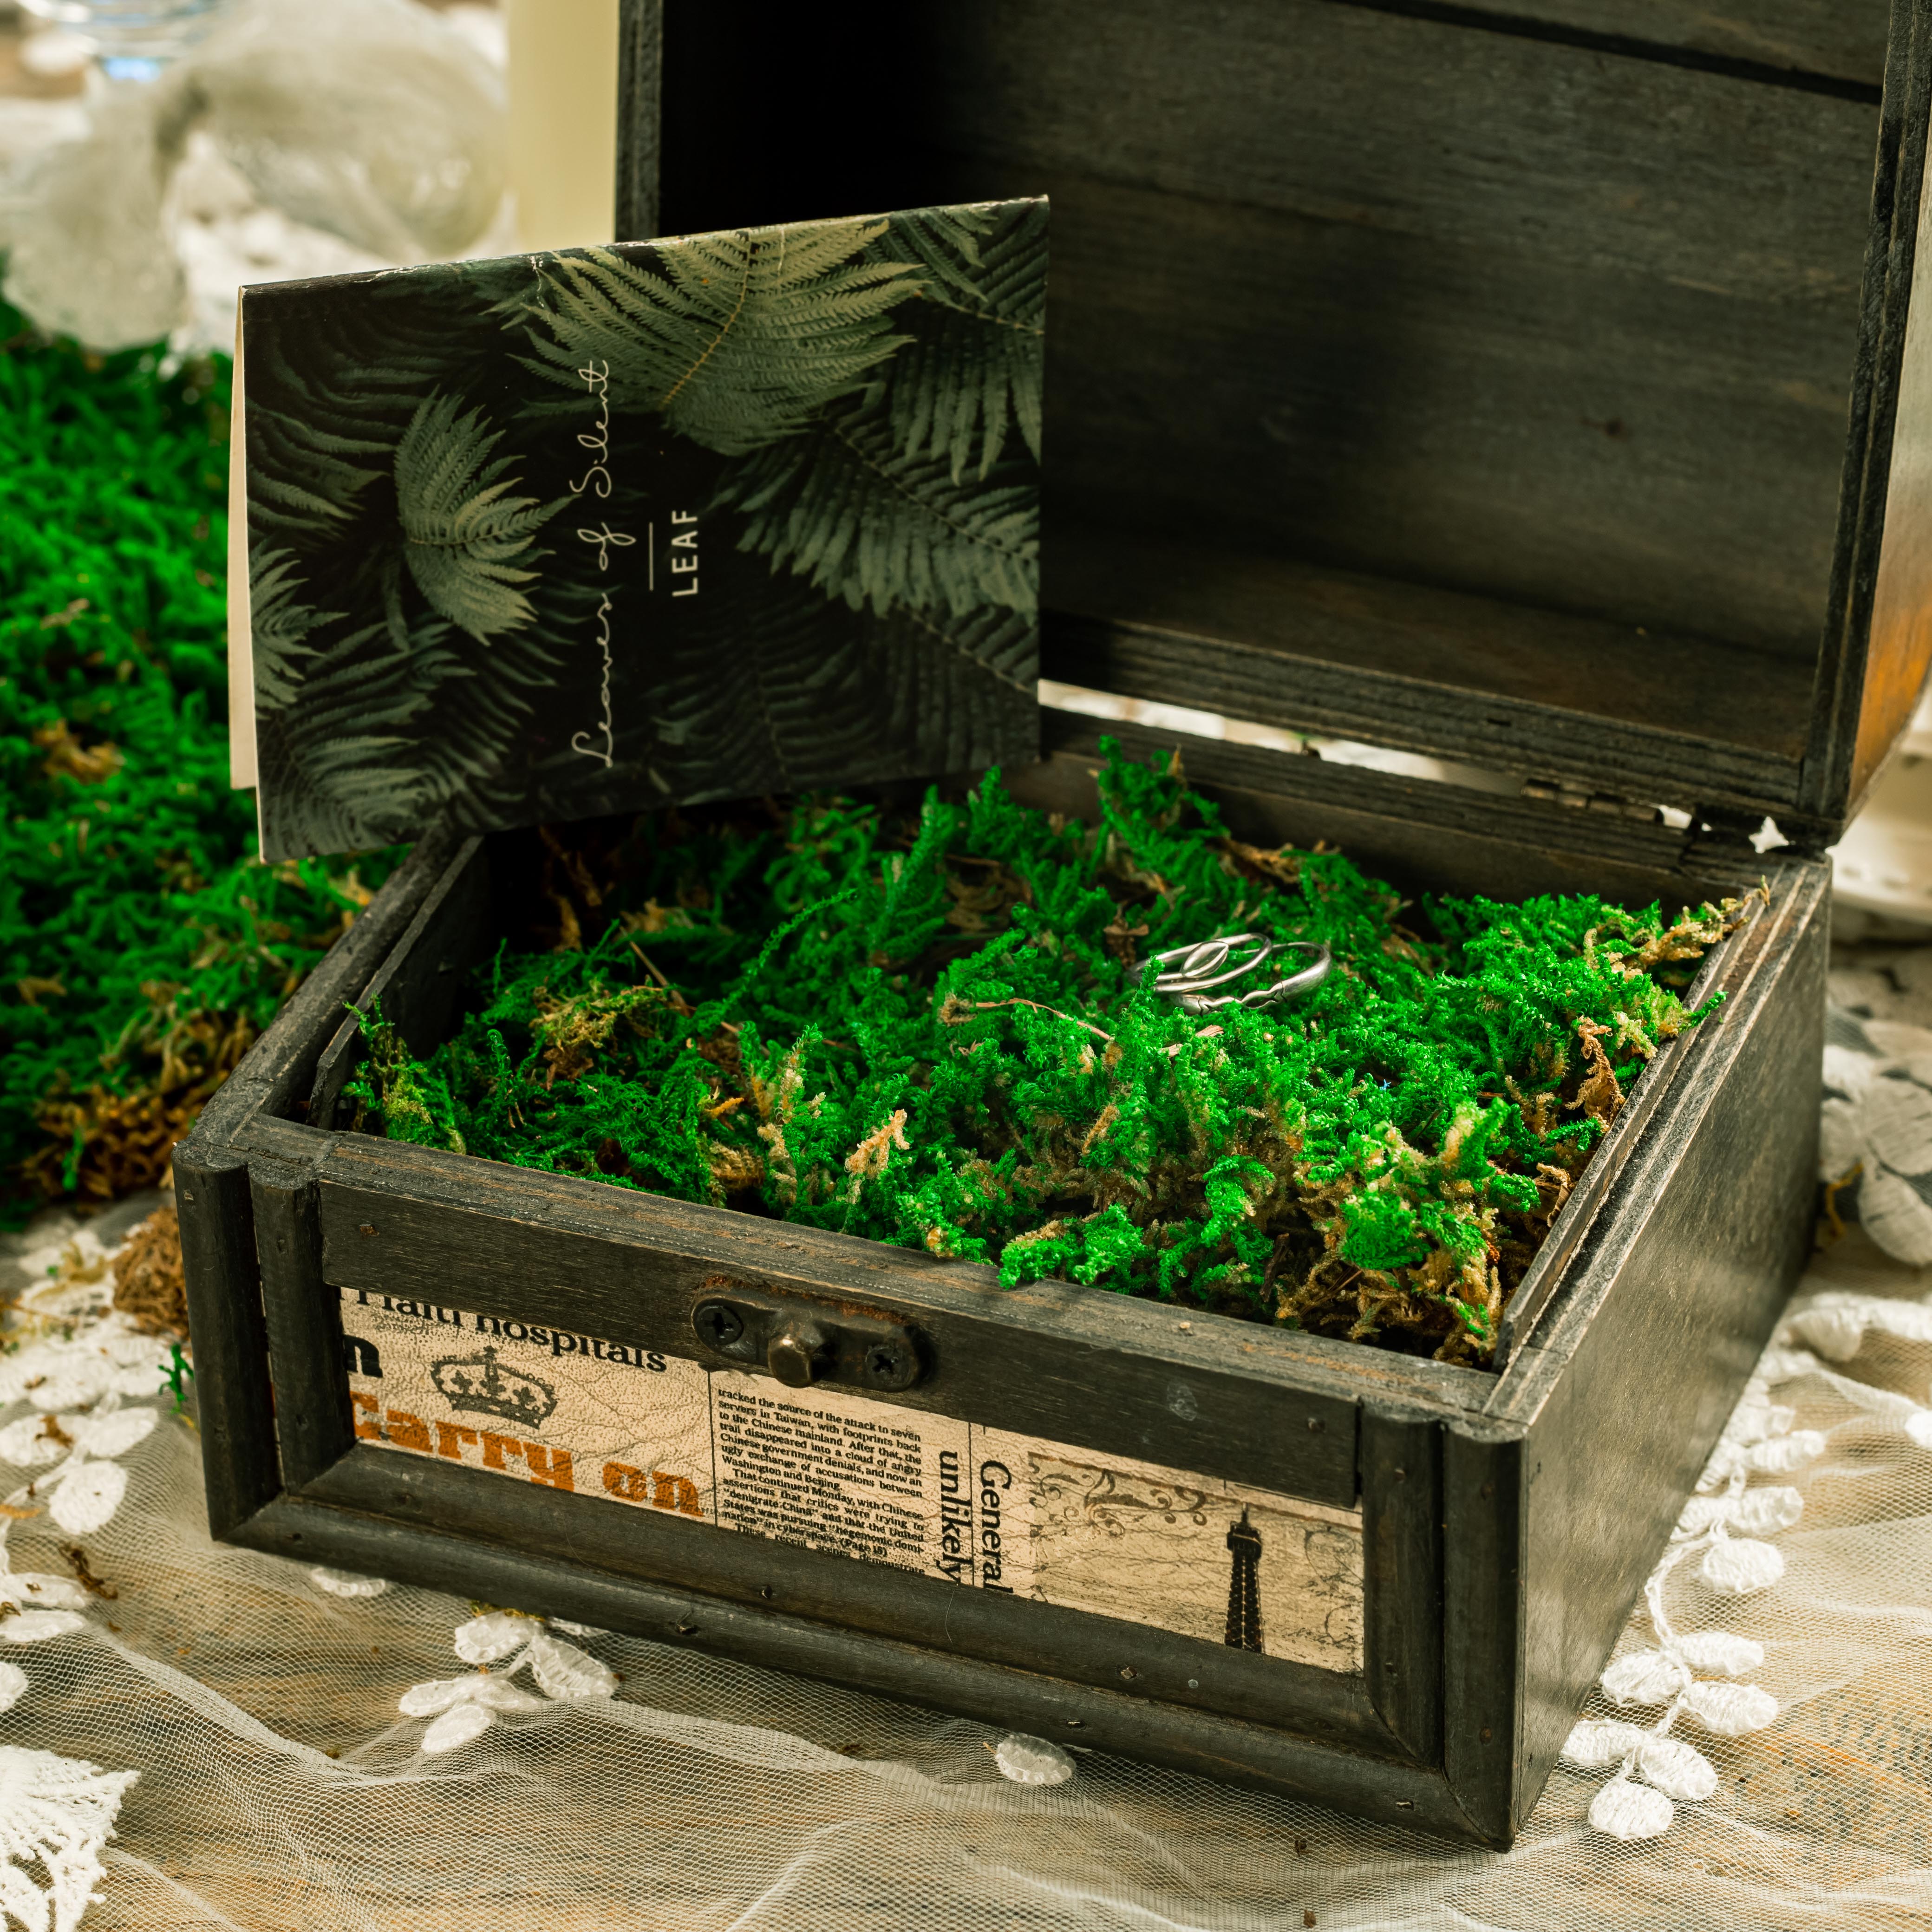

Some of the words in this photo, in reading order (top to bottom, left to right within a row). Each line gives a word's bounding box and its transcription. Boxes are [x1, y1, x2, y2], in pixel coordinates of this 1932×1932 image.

[568, 359, 611, 498] Silent
[577, 522, 636, 571] of
[671, 510, 698, 597] LEAF
[570, 593, 613, 768] Leaves
[475, 1314, 667, 1372] hospitals
[718, 1388, 756, 1404] tracked
[758, 1397, 775, 1408] the
[777, 1403, 811, 1416] source
[813, 1410, 823, 1419] of
[825, 1412, 842, 1423] the
[844, 1418, 875, 1431] attack
[878, 1425, 888, 1433] to
[890, 1429, 920, 1442] seven
[718, 1400, 757, 1416] servers
[773, 1411, 814, 1429] Taiwan,
[816, 1423, 839, 1434] with
[842, 1427, 893, 1446] footprints
[896, 1439, 921, 1453] back
[719, 1411, 729, 1420] to
[732, 1414, 748, 1424] the
[751, 1418, 792, 1434] Chinese
[848, 1441, 875, 1453] After
[878, 1447, 902, 1461] that,
[904, 1453, 921, 1464] the
[350, 1391, 574, 1491] Carry
[603, 1462, 704, 1517] on
[719, 1422, 740, 1434] trail
[744, 1428, 807, 1449] disappeared
[810, 1443, 831, 1454] into
[845, 1451, 873, 1464] cloud
[876, 1458, 887, 1467] of
[891, 1462, 921, 1476] angry
[720, 1433, 761, 1449] Chinese
[762, 1443, 823, 1464] government
[824, 1456, 864, 1475] denials,
[865, 1468, 884, 1478] and
[886, 1472, 907, 1483] now
[908, 1478, 922, 1487] an
[721, 1444, 743, 1456] ugly
[748, 1451, 796, 1469] exchange
[800, 1463, 811, 1471] of
[815, 1467, 875, 1487] accusations
[879, 1480, 922, 1498] between
[721, 1454, 781, 1476] Washington
[783, 1470, 802, 1481] and
[804, 1474, 842, 1491] Beijing.
[722, 1478, 775, 1496] assertions
[780, 1490, 801, 1502] that
[843, 1507, 870, 1518] were
[875, 1513, 907, 1529] trying
[913, 1522, 924, 1531] to
[723, 1499, 756, 1514] States
[757, 1508, 778, 1519] was
[780, 1514, 826, 1532] pursuing
[732, 1468, 757, 1481] That
[758, 1475, 809, 1493] continued
[811, 1486, 855, 1506] Monday,
[856, 1498, 880, 1510] with
[881, 1503, 924, 1520] Chinese
[936, 1450, 972, 1586] unlikely
[821, 1512, 842, 1523] and
[844, 1517, 865, 1528] that
[868, 1522, 885, 1534] the
[980, 1460, 1013, 1593] General
